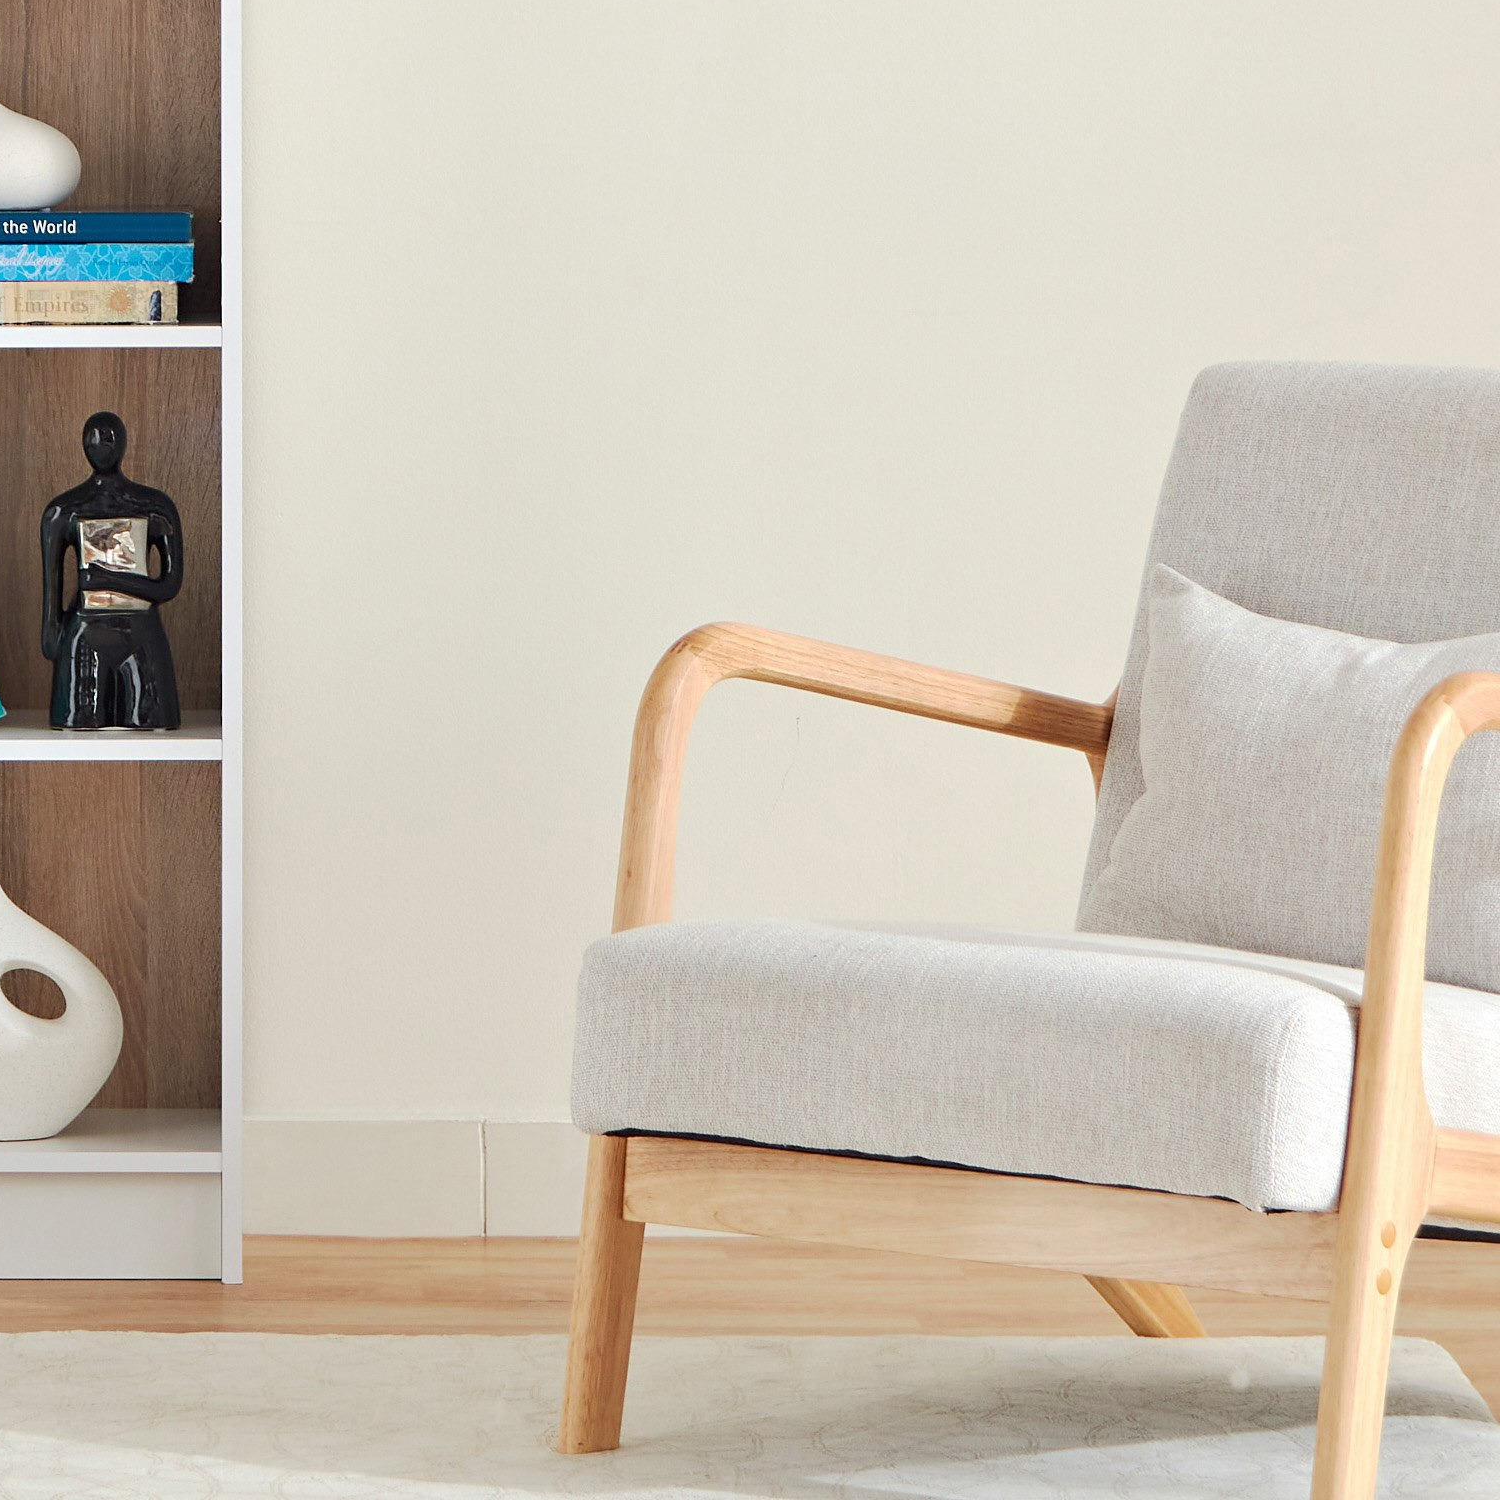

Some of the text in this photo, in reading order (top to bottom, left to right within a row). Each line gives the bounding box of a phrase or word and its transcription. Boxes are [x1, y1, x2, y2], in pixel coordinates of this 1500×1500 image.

[3, 219, 28, 234] the
[33, 219, 76, 234] World
[13, 295, 89, 317] Empires
